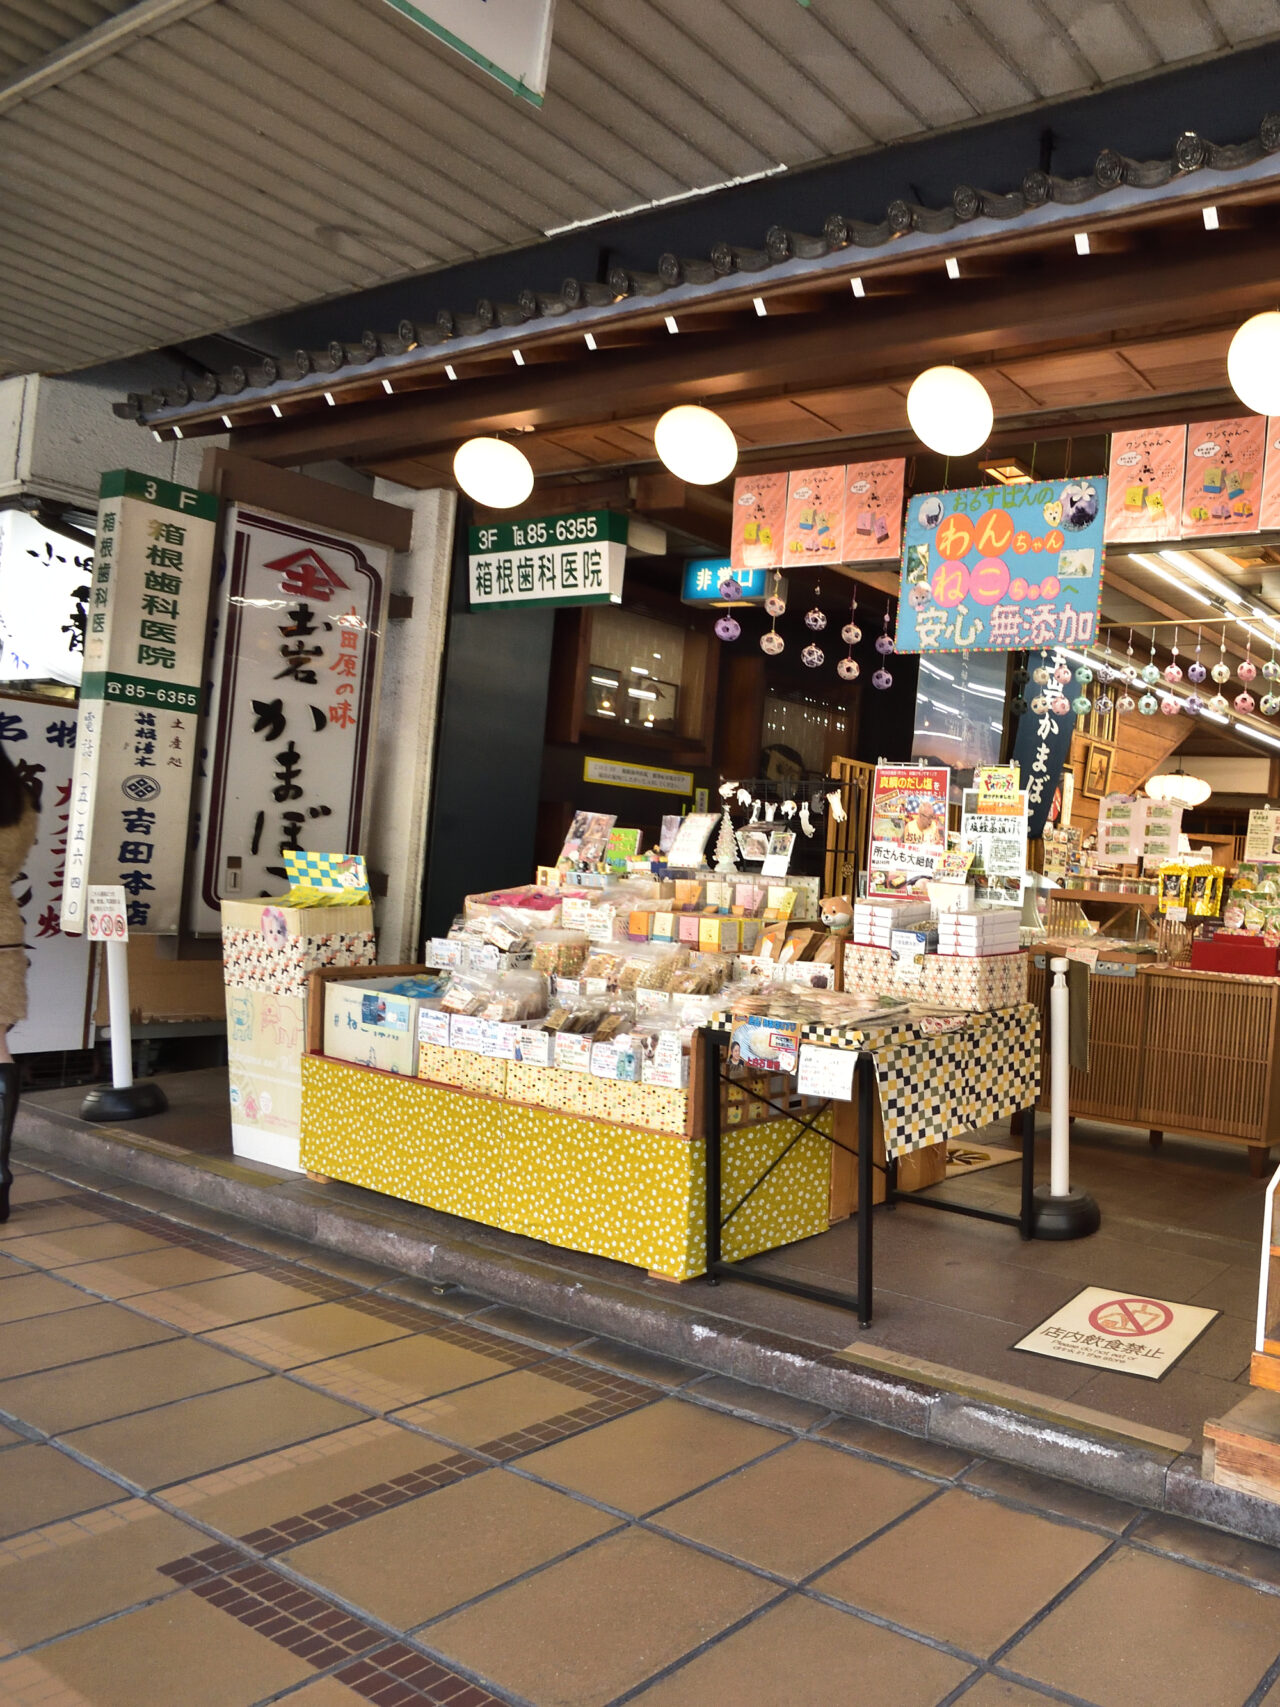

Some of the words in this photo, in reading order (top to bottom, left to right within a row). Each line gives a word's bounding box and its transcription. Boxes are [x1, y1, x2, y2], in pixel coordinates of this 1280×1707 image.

[1126, 439, 1172, 449] ワンちゃんへ
[1206, 429, 1249, 439] ワンちゃんへ
[953, 487, 1055, 512] おるすばんの
[478, 529, 498, 550] 3F
[527, 516, 598, 543] 85-6355
[939, 513, 1062, 556] わんちゃん
[136, 518, 187, 670] 箱根歯科医院
[475, 549, 603, 597] 箱根歯科医院
[915, 604, 984, 648] 安心
[989, 603, 1094, 646] 無添加
[329, 605, 359, 730] 小田原の味
[125, 683, 197, 706] 85-6355
[134, 711, 157, 768] 箱根湯本
[167, 718, 184, 769] 土産処
[117, 806, 158, 927] 吉田本店
[1041, 1326, 1165, 1360] 店内飲食禁止
